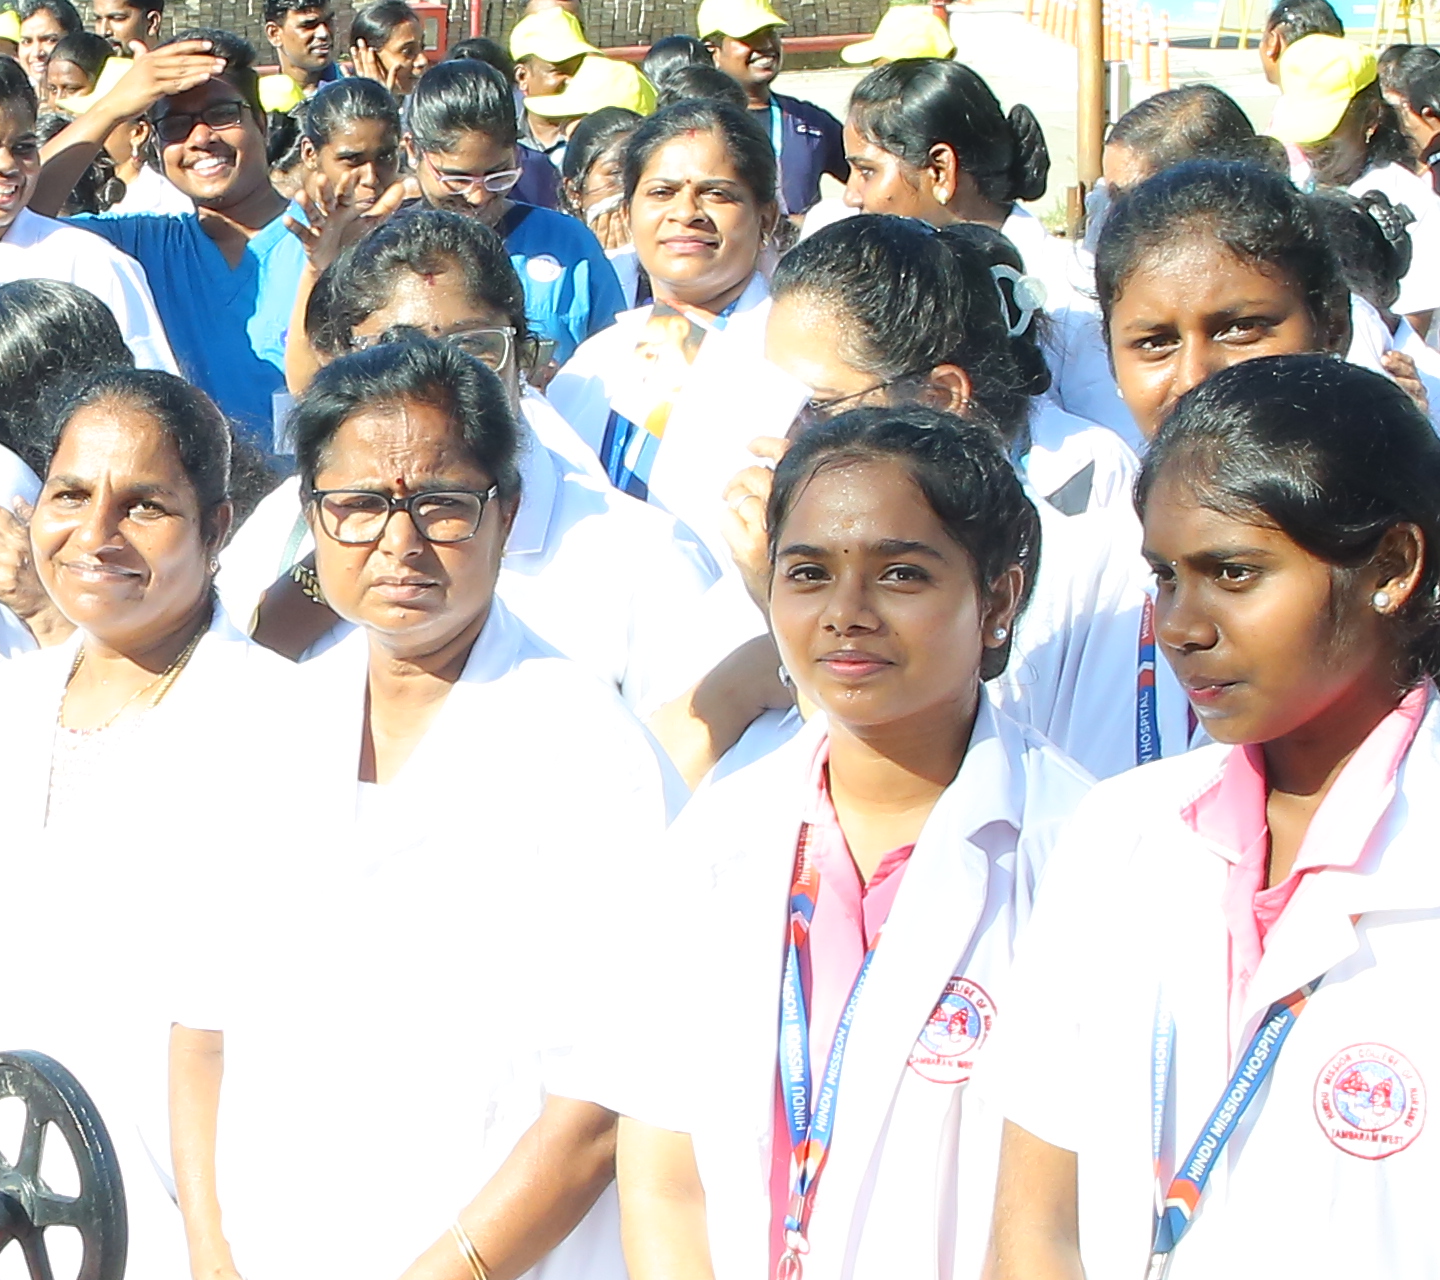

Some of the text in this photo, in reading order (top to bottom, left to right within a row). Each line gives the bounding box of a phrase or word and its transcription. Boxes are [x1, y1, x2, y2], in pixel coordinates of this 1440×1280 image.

[1138, 690, 1150, 754] HOSPITAL
[789, 1023, 806, 1083] MISSION
[823, 1028, 846, 1085] MISSION
[1154, 1036, 1168, 1101] MISSION
[790, 1086, 807, 1132] HINDU
[817, 1089, 834, 1133] HINDU
[1186, 1013, 1289, 1182] HINDU MISSION HOSPITAL
[1381, 1134, 1404, 1146] WEST
